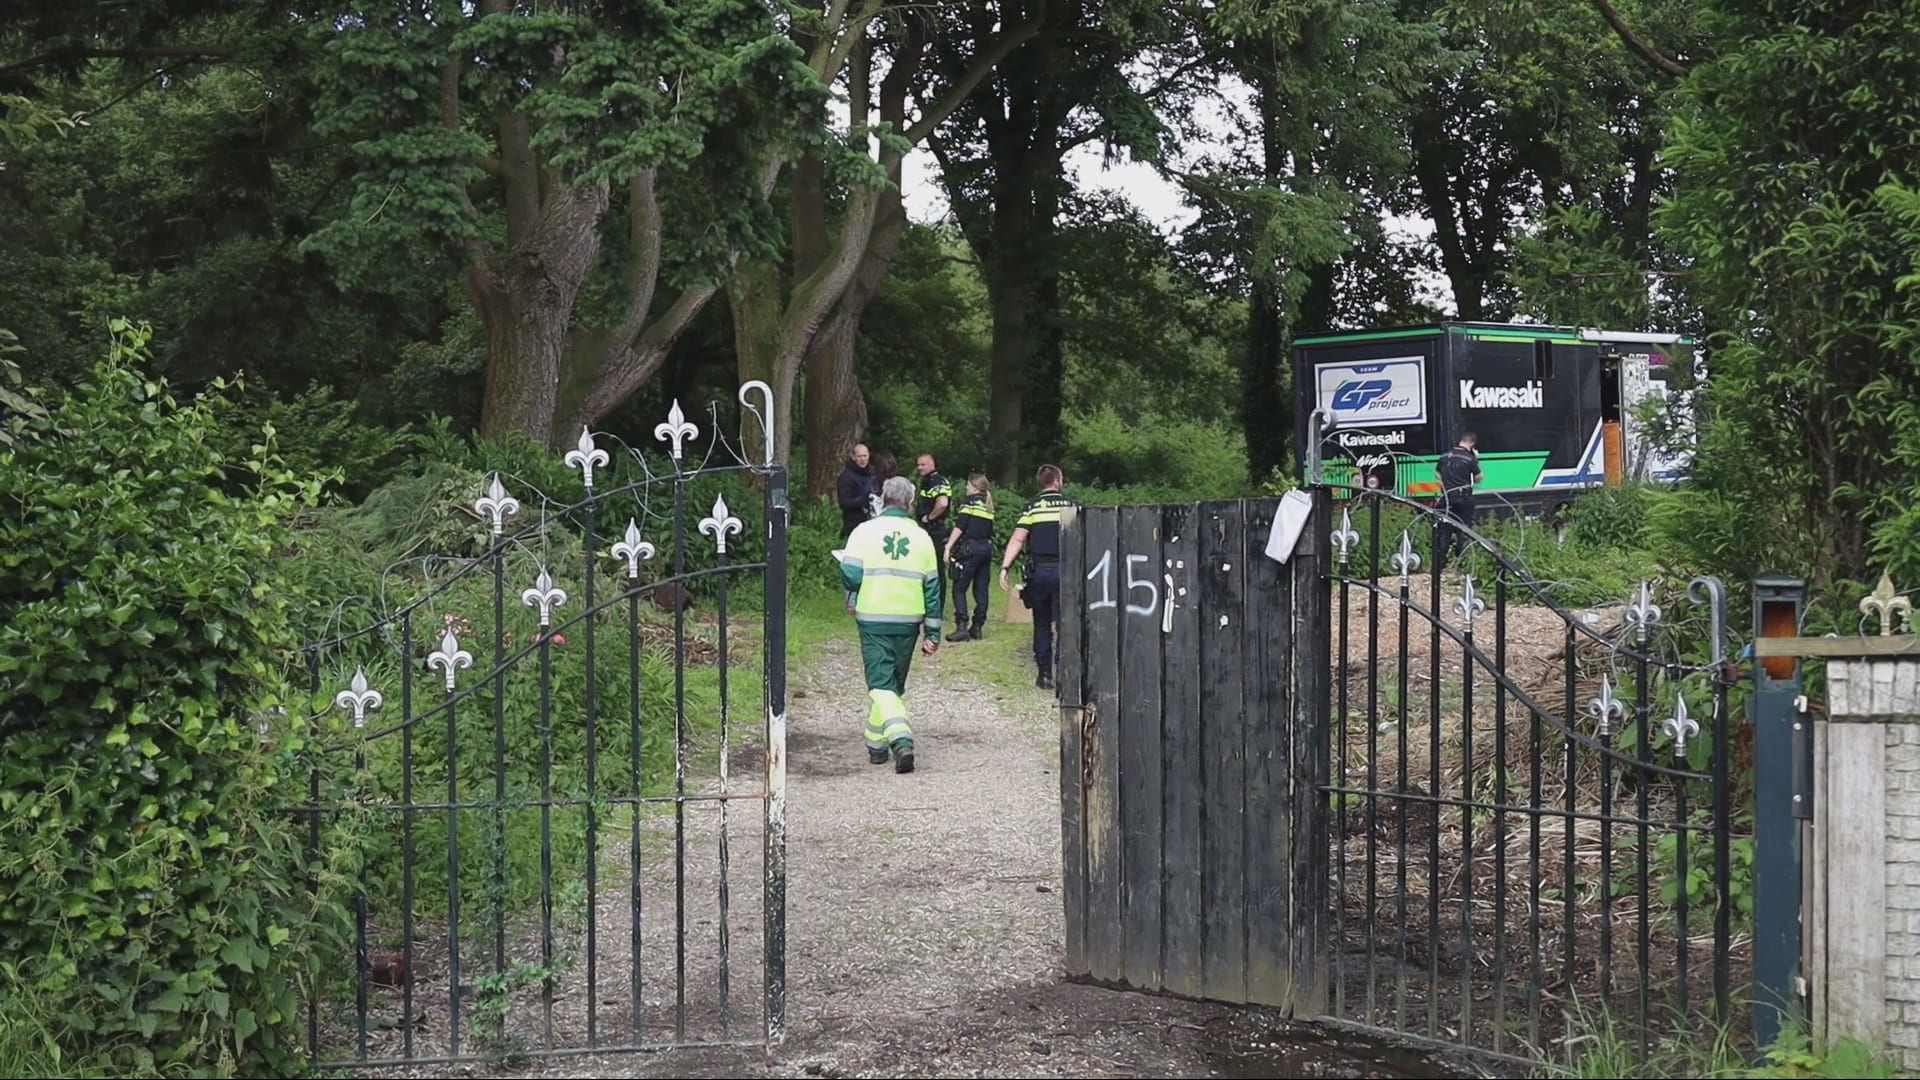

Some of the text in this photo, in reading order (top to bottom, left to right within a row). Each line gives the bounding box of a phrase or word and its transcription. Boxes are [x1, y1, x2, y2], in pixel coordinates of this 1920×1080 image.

[1331, 380, 1410, 412] GP project
[1459, 379, 1543, 408] Kawasaki
[1340, 431, 1405, 447] Kawasaki
[1356, 454, 1390, 468] Ninja
[1087, 549, 1158, 616] 15
